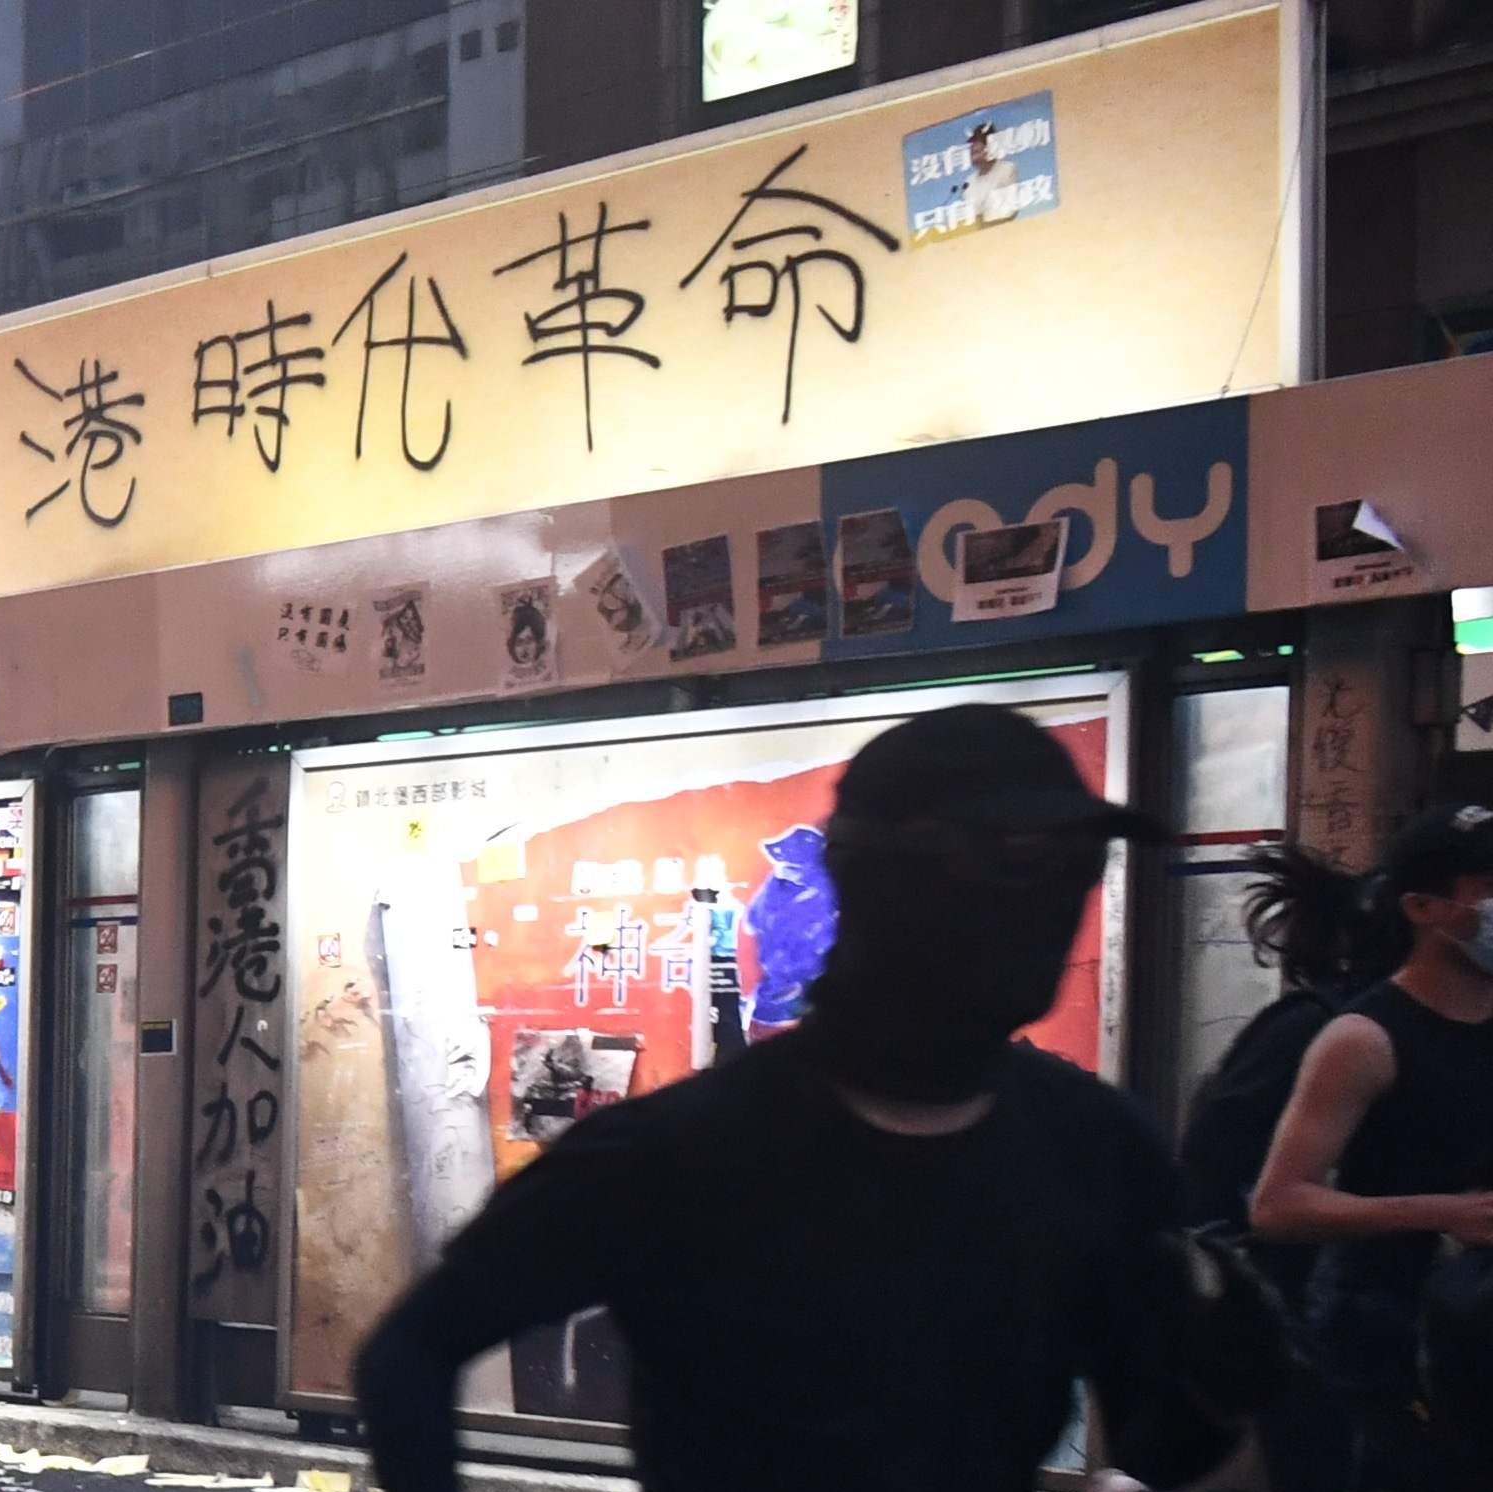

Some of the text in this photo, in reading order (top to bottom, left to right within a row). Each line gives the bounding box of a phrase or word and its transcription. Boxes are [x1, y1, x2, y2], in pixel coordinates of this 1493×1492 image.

[196, 776, 284, 1298] 香港人加油
